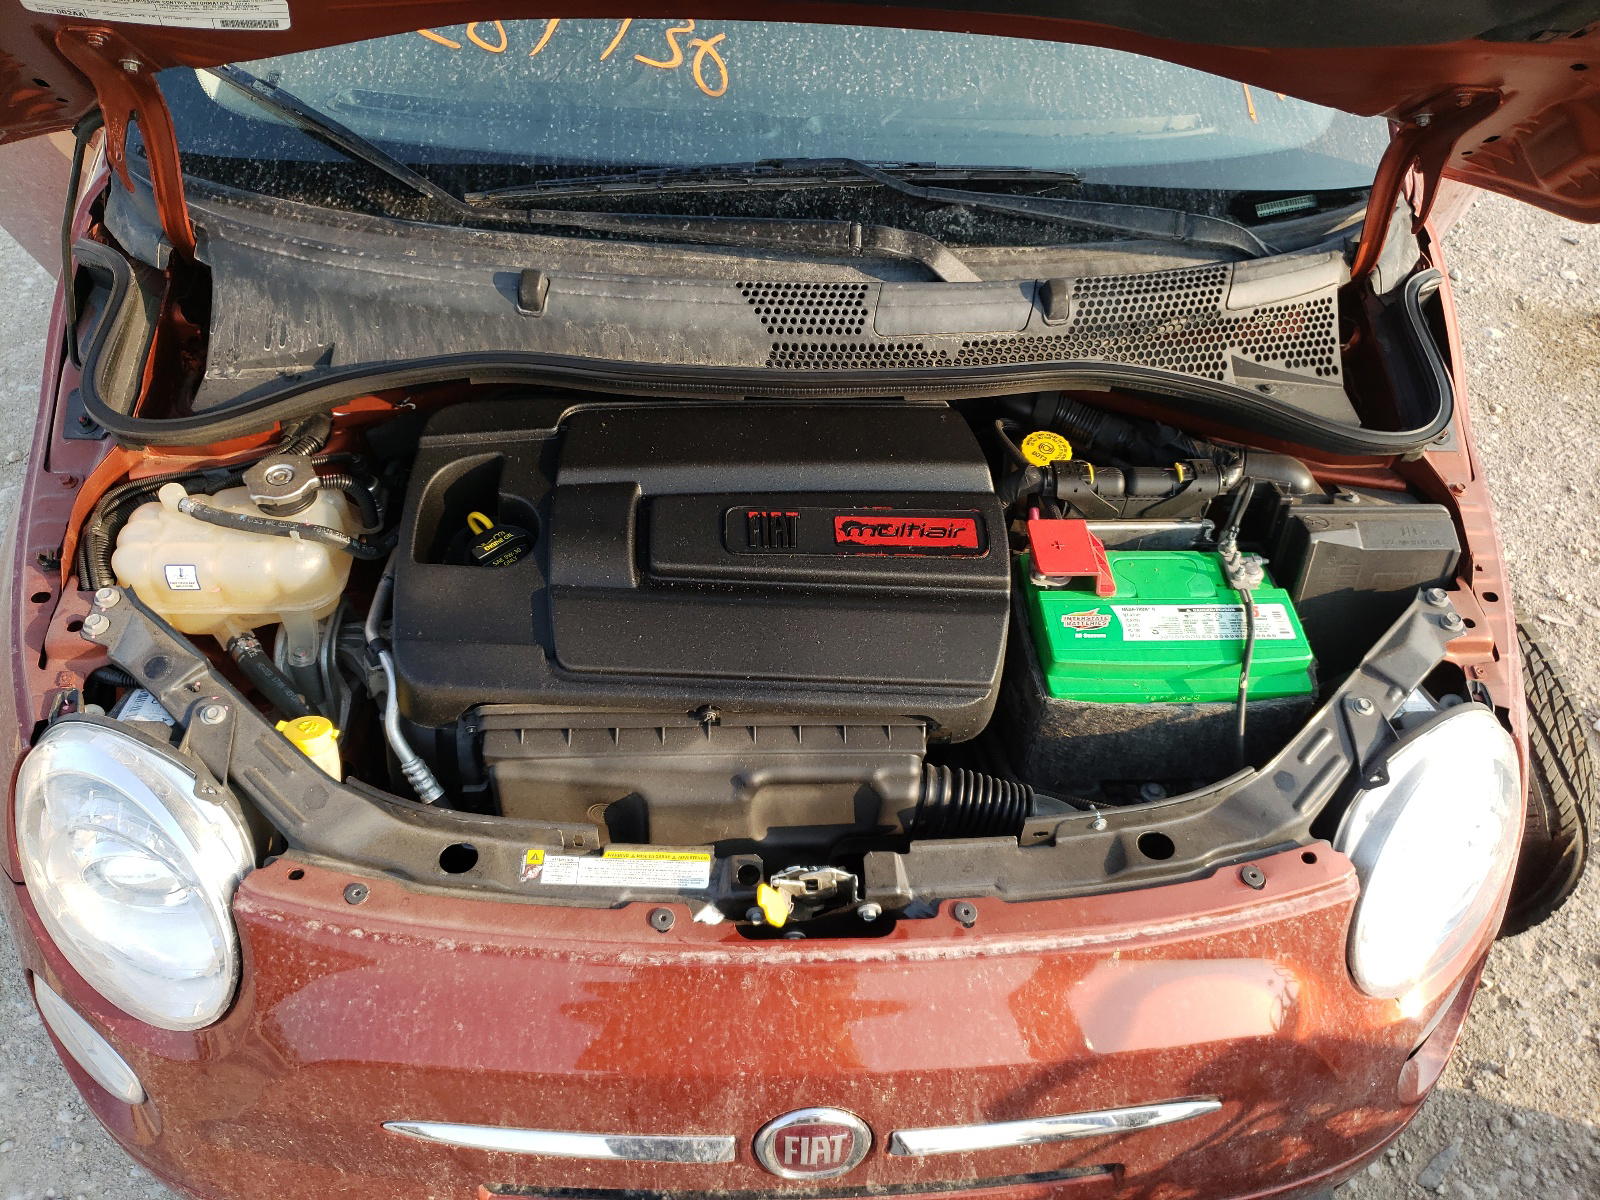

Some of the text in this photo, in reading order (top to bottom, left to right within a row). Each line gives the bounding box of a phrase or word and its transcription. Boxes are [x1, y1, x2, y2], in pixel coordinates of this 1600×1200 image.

[747, 511, 966, 549] FIAT multiair
[784, 1133, 848, 1166] FIAT
